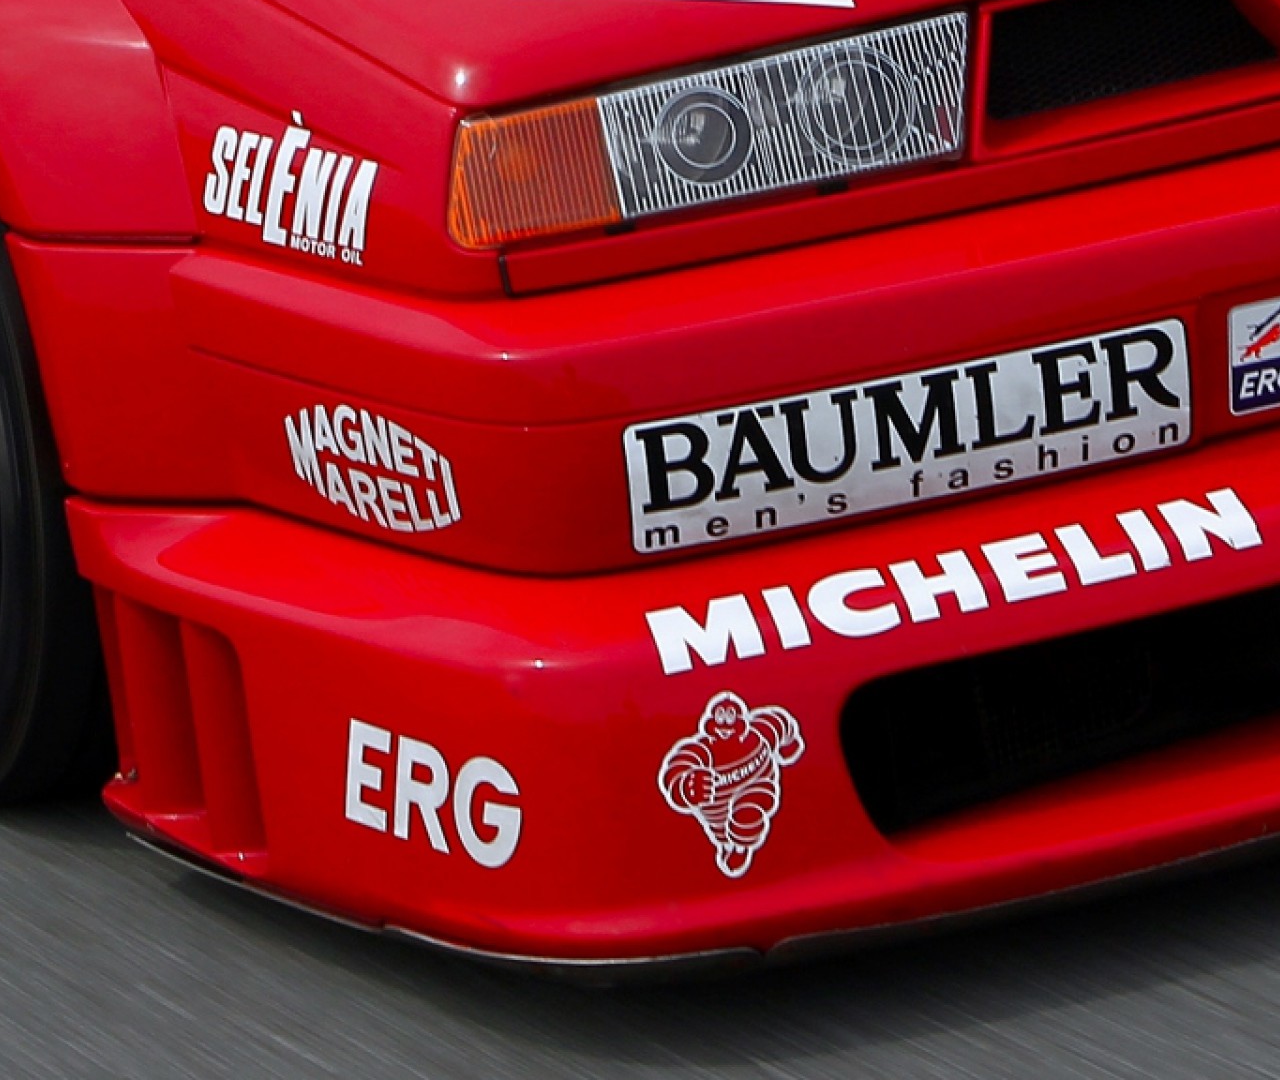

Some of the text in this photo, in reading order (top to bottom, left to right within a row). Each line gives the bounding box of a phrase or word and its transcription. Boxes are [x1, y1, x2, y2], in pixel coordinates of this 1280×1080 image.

[290, 235, 364, 267] MOTOR OIL
[284, 404, 460, 505] MAGNETI
[635, 328, 1181, 514] BÄUMLER
[289, 445, 461, 533] MARELLI
[644, 422, 1179, 549] men's fashion
[644, 487, 1262, 675] MICHELIN
[345, 718, 523, 869] ERG
